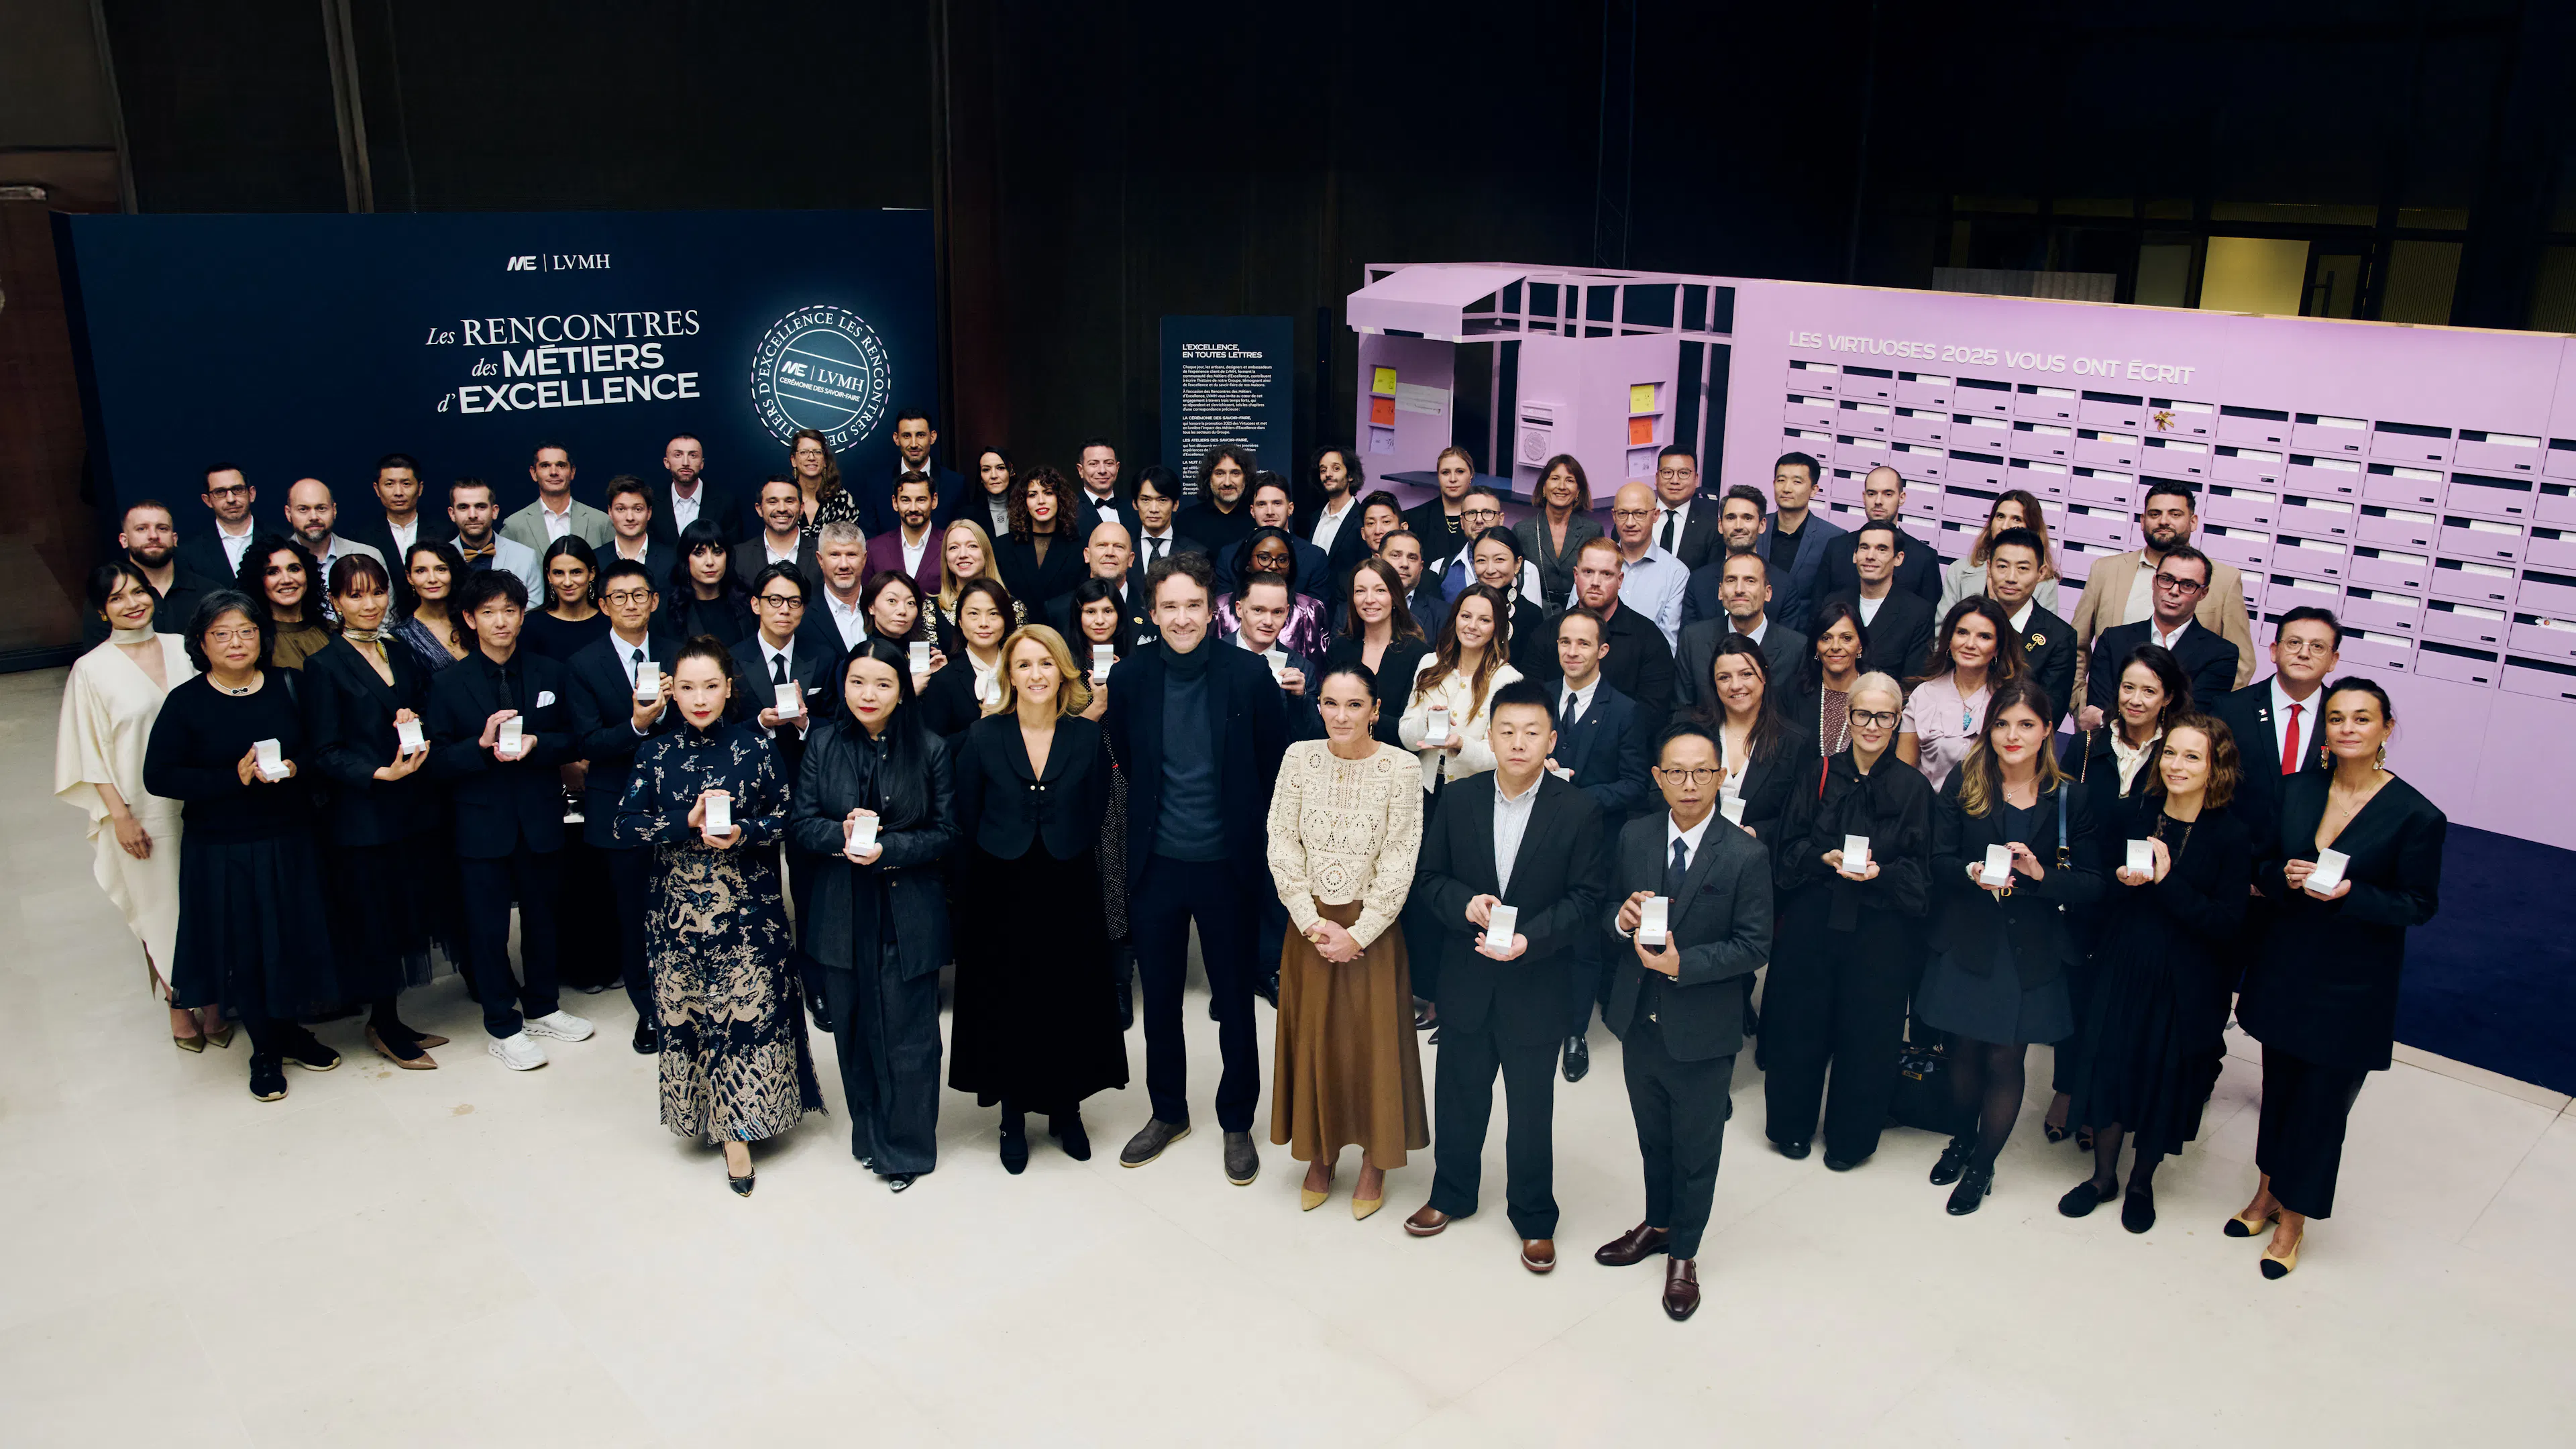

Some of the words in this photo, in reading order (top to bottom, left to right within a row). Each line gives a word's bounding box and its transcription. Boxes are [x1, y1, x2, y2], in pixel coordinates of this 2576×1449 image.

[506, 256, 537, 271] ME
[553, 254, 611, 270] LVMH
[425, 327, 455, 345] Les
[460, 309, 700, 346] RENCONTRES
[838, 316, 863, 337] LES
[757, 312, 834, 394] D'EXCELLENCE
[1183, 343, 1240, 352] L'EXCELLENCE,
[1788, 330, 1823, 350] LES
[1827, 334, 1937, 362] VIRTUOSES
[1941, 344, 1998, 367] 2025
[2004, 350, 2066, 374] VOUS
[2072, 357, 2122, 380] ONT
[2126, 360, 2196, 386] ÉCRIT
[472, 358, 498, 377] des
[502, 342, 665, 378] MÉTIERS
[817, 368, 865, 392] LVMH
[850, 335, 884, 436] RENCONTRES
[812, 385, 824, 393] DES
[824, 387, 861, 402] SAVOIR-FAIRE
[826, 431, 849, 447] DE
